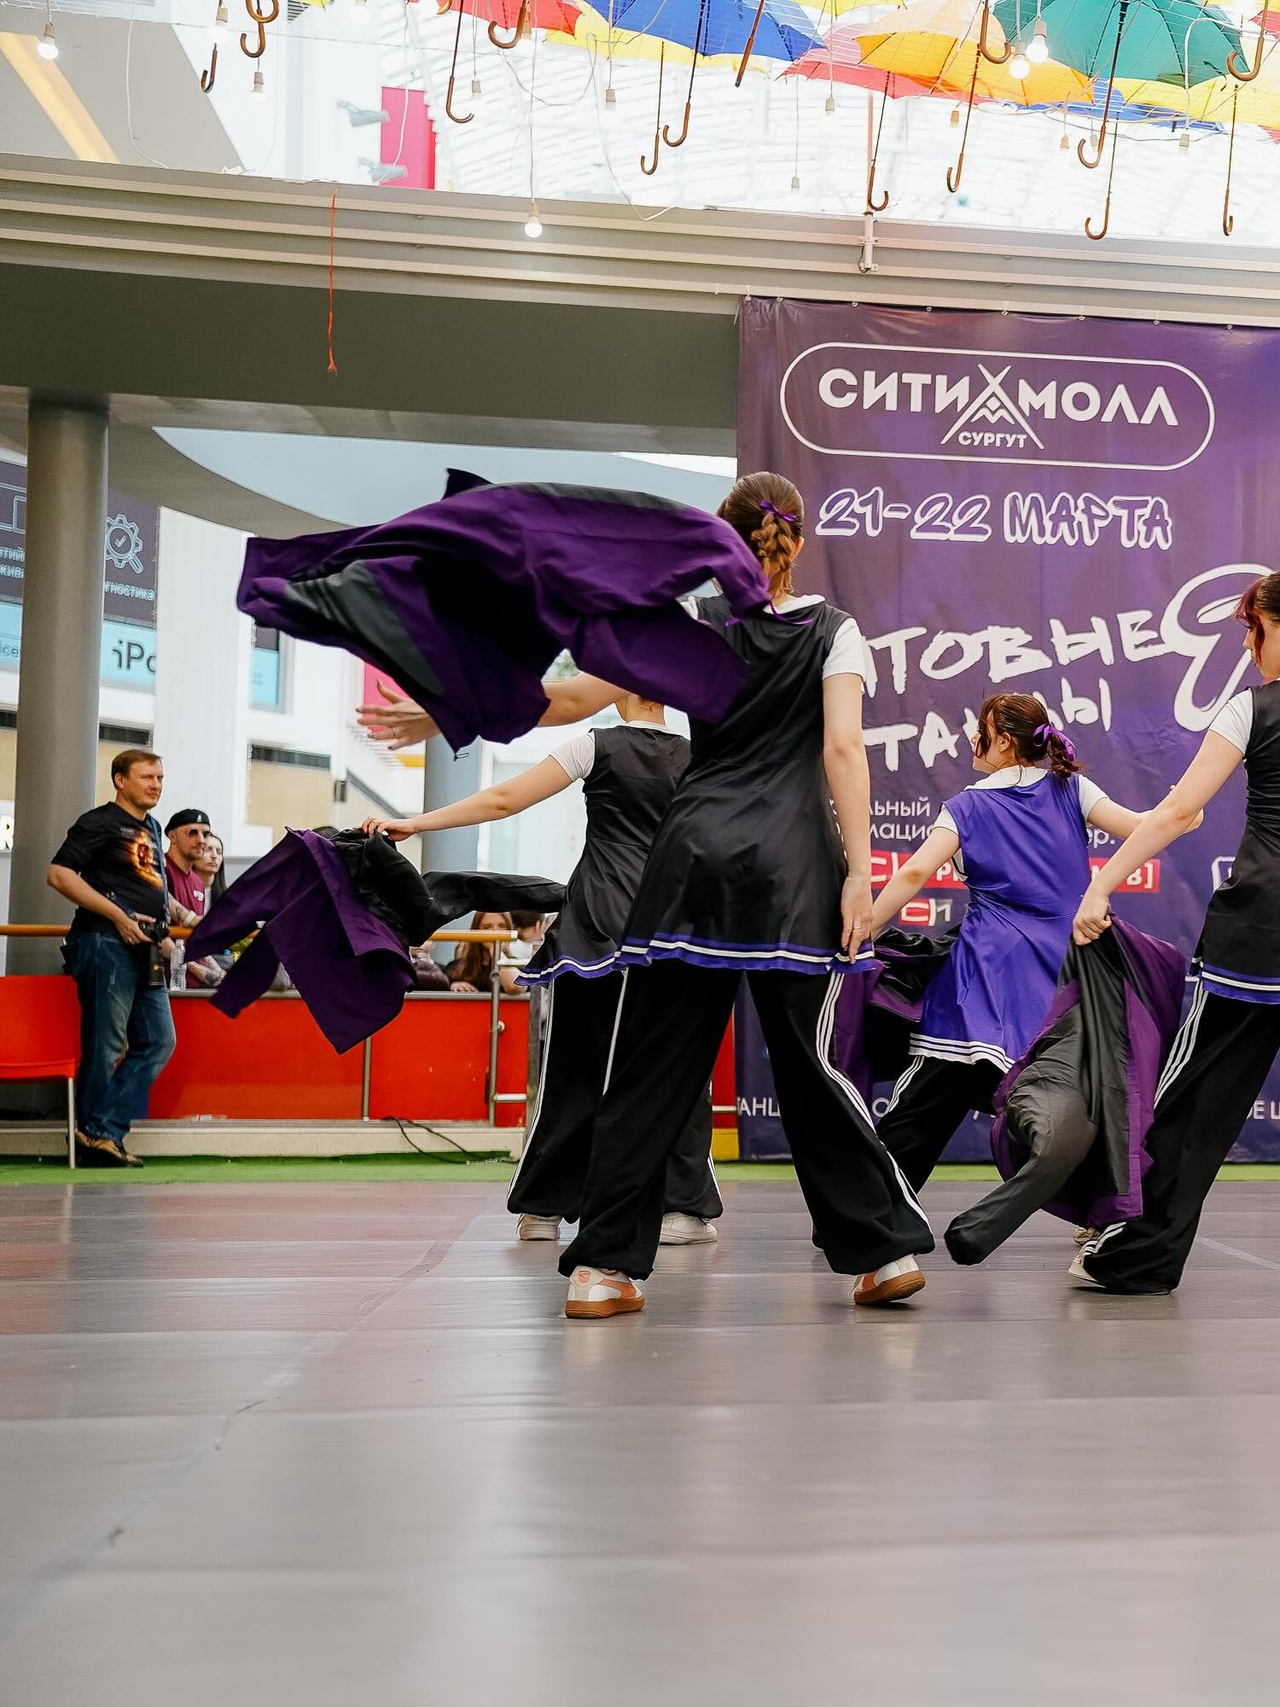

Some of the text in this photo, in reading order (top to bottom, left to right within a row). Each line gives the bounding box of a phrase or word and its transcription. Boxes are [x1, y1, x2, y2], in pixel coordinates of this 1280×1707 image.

[957, 430, 1027, 449] СУРГУТ
[815, 487, 1173, 550] 21-22 МАРТА
[105, 580, 156, 602] гностика
